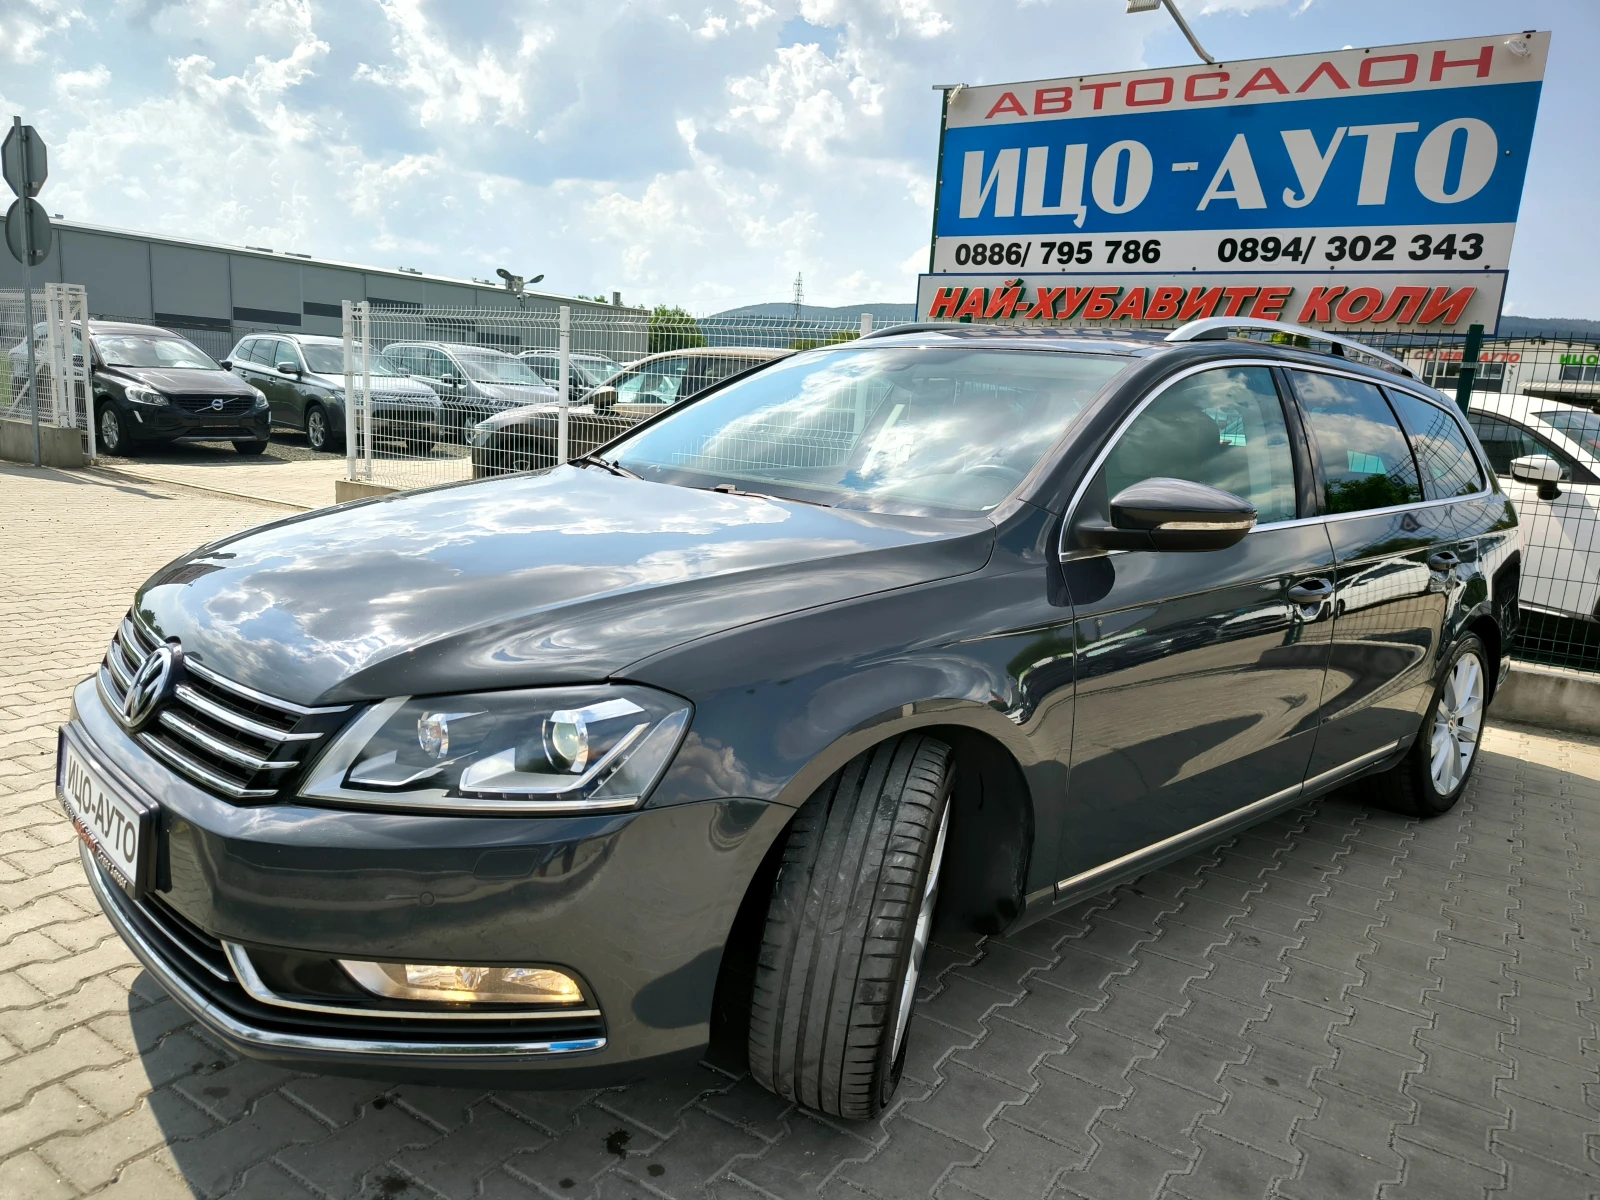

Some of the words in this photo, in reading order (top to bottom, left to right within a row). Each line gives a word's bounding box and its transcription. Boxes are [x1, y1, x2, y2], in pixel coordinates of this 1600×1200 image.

[985, 46, 1494, 119] АВТОСАЛОН
[954, 242, 1031, 266] 0886/
[1040, 241, 1093, 265] 795
[1104, 239, 1162, 264] 786
[1217, 236, 1316, 264] 0894/
[1325, 235, 1395, 262] 302
[1407, 233, 1485, 261] 343
[927, 278, 1296, 320] НАЙ-ХУБАВИТЕ
[1295, 285, 1478, 325] КОЛИ
[1479, 352, 1521, 363] АУТО
[67, 754, 136, 864] ИЦО-АУТО
